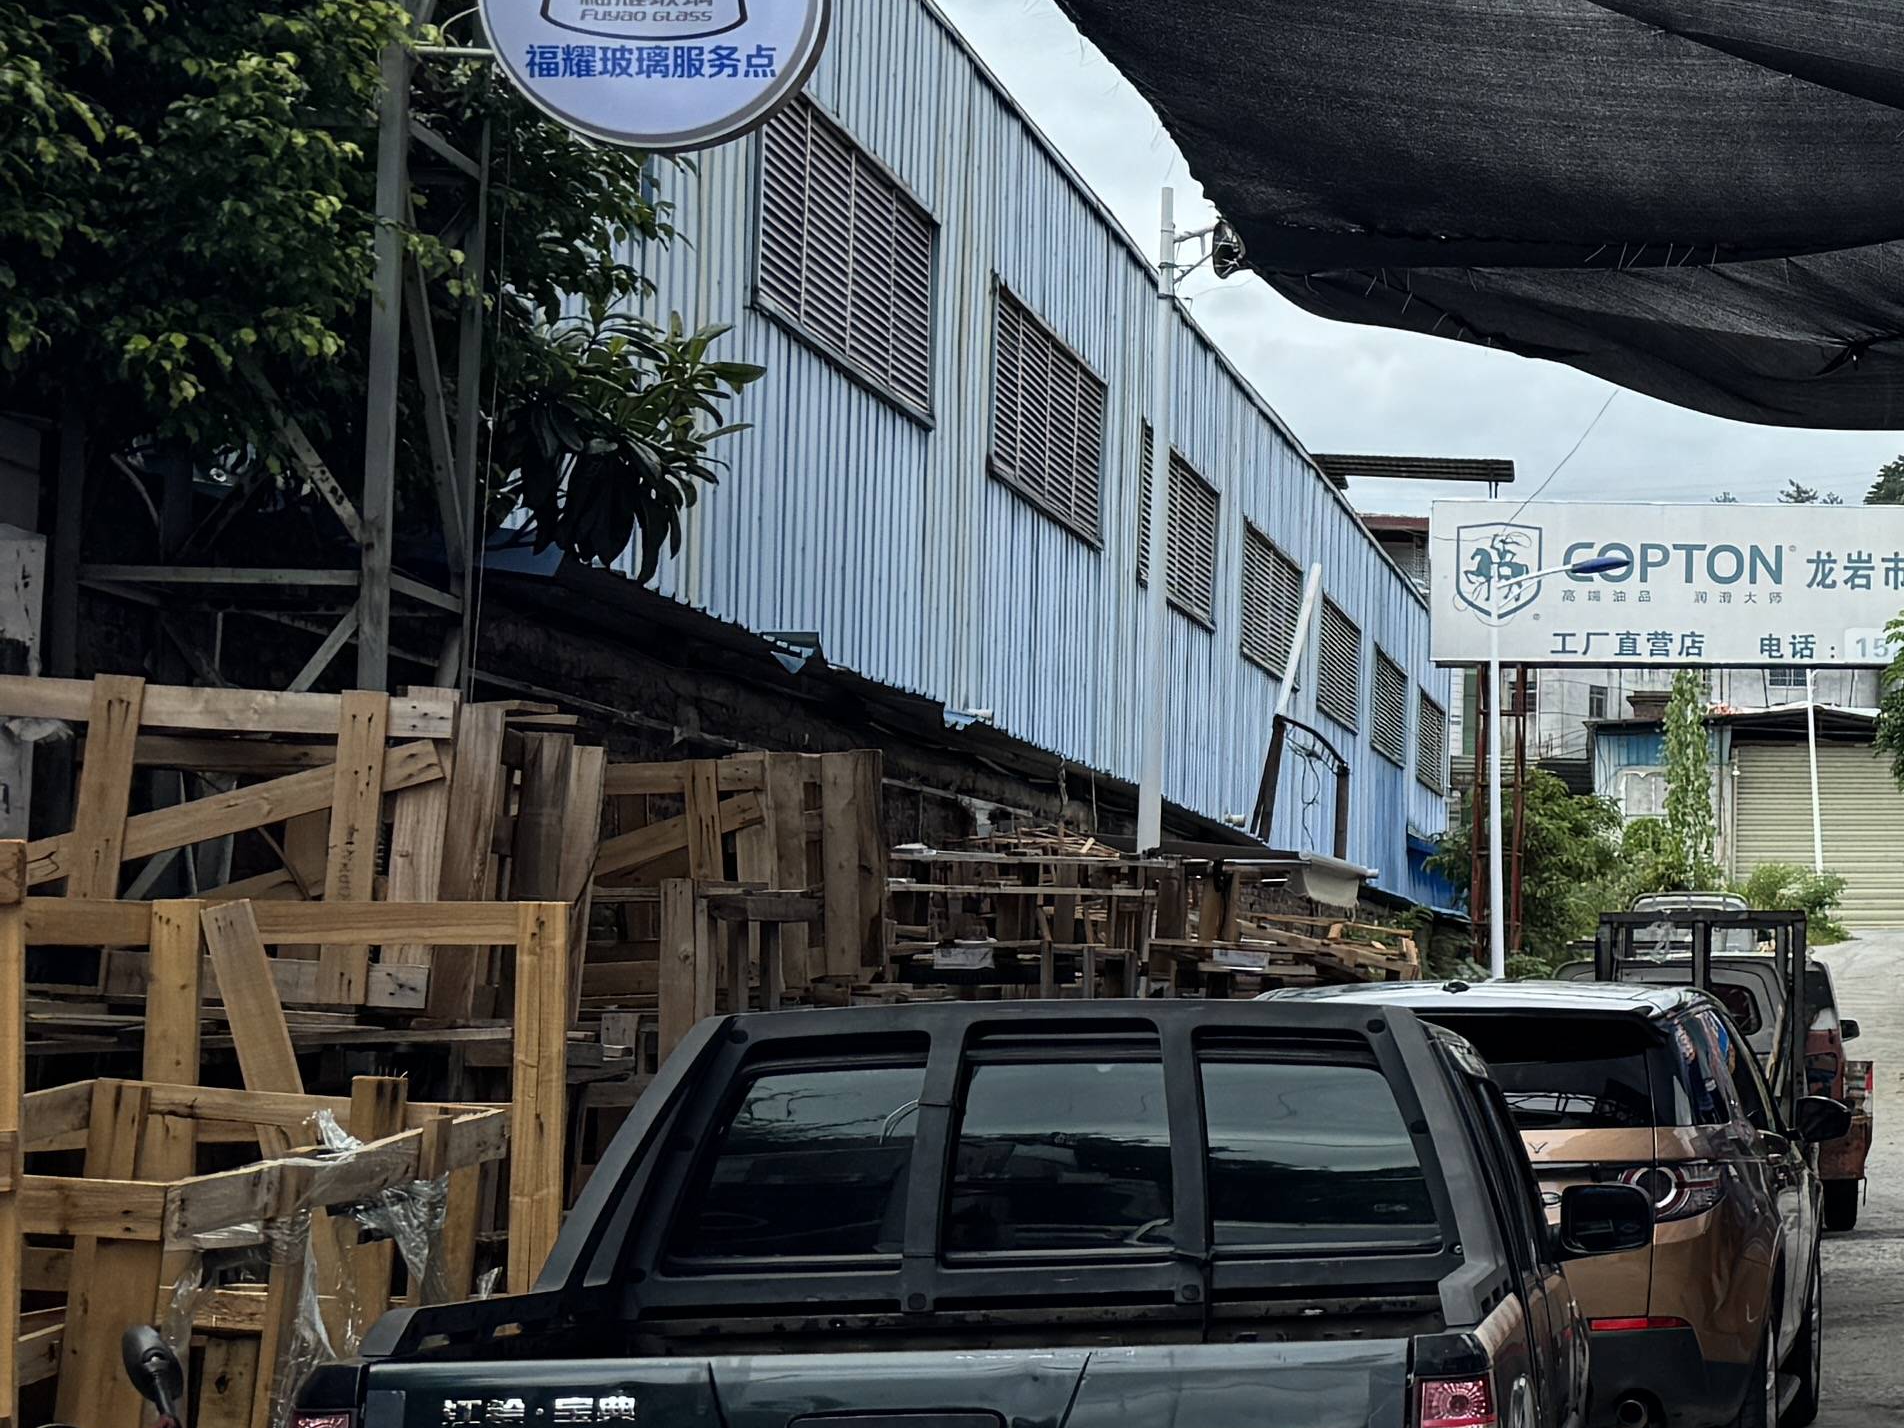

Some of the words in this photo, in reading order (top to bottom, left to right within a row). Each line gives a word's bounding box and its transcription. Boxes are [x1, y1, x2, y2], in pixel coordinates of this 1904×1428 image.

[525, 44, 777, 79] 福耀玻璃服务点
[1562, 541, 1784, 586] COPTON
[1550, 631, 1705, 658] 工厂直营店
